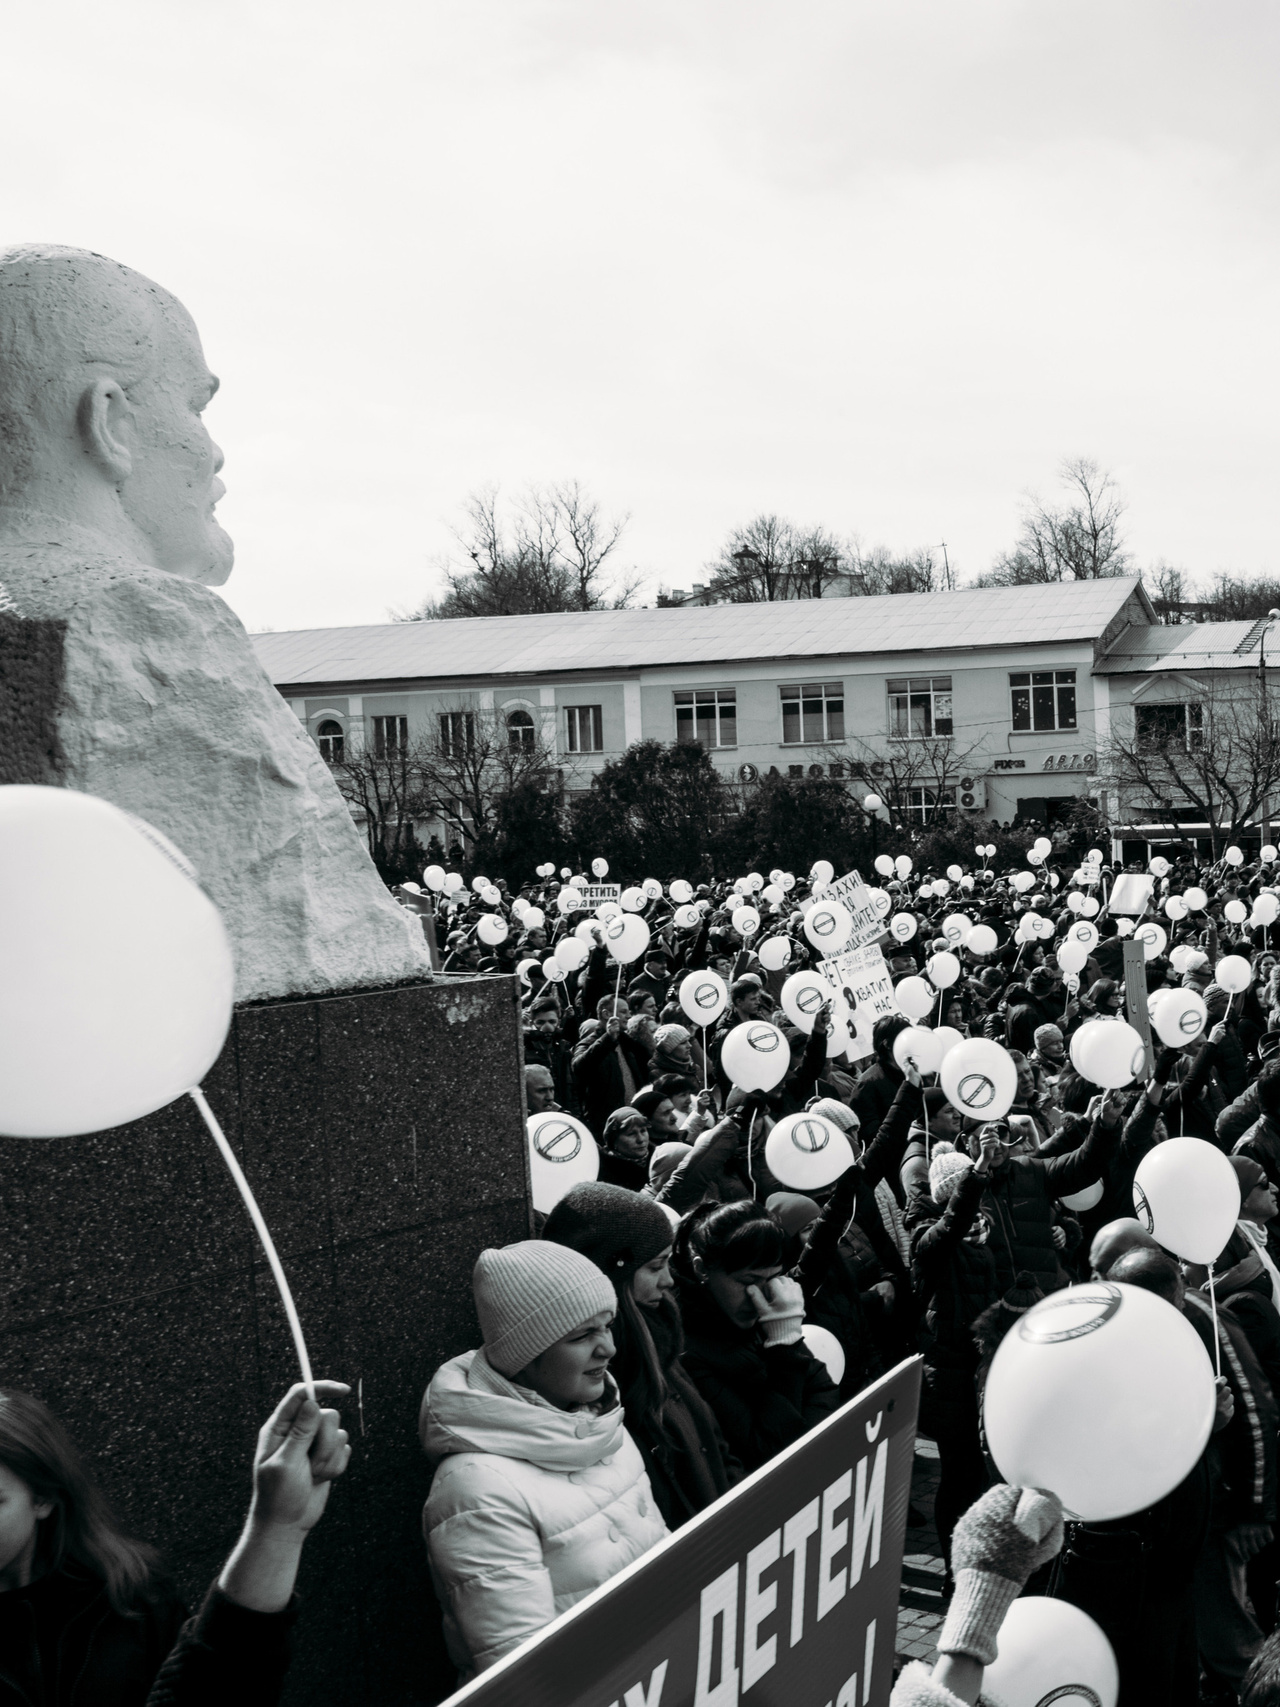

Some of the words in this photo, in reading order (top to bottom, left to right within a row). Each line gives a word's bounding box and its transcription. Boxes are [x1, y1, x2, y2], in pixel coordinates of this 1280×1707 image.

[1043, 754, 1093, 765] АВТО
[577, 887, 618, 897] ПРЕТИТЬ
[855, 977, 889, 1004] ХВАТИТ
[873, 996, 892, 1014] НАС
[693, 1411, 888, 1707] ДЕТЕЙ
